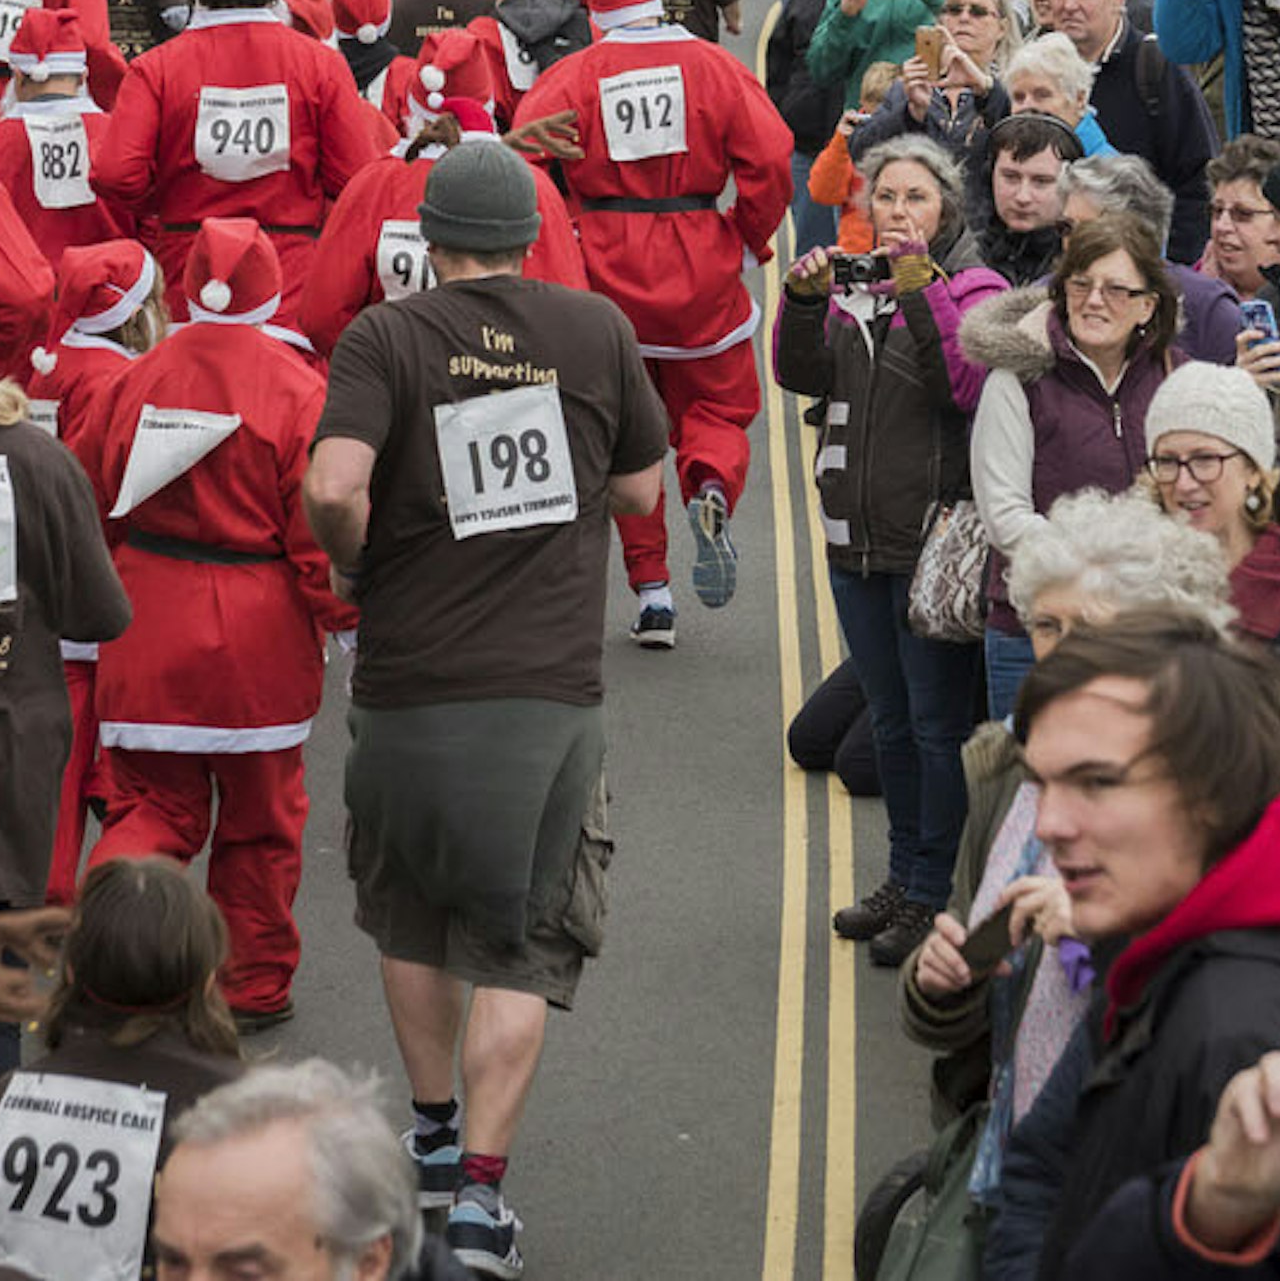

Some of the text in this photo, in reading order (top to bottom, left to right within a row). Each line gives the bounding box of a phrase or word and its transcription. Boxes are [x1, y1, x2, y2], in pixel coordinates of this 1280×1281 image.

[615, 92, 673, 134] 912
[210, 116, 276, 155] 940
[40, 141, 82, 180] 882
[481, 325, 515, 353] I'm
[467, 428, 552, 495] 198
[3, 1094, 157, 1133] CORNWALL HOSPICE CARE
[2, 1136, 121, 1229] 923
